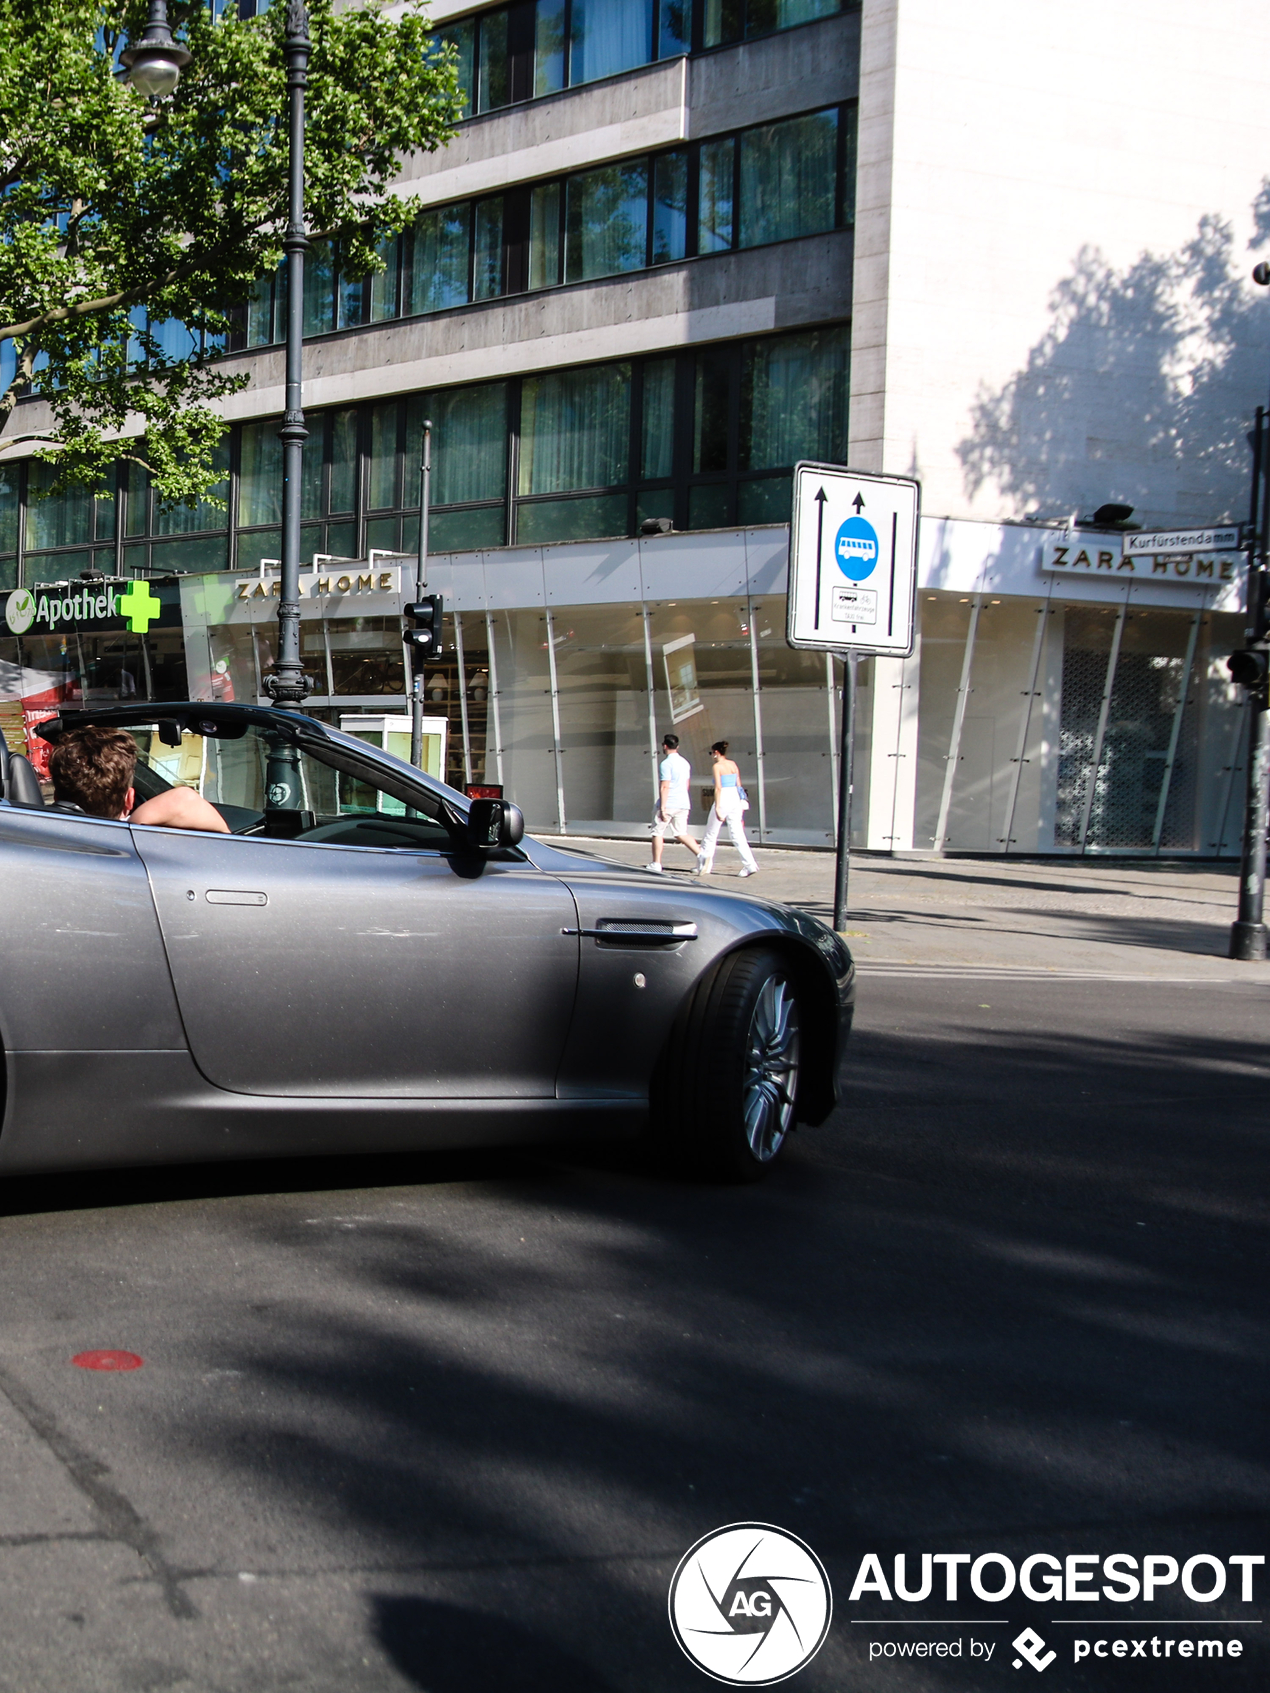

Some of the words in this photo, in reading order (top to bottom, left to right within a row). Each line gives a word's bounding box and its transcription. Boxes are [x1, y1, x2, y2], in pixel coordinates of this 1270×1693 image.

[1129, 532, 1235, 549] Kurfürstendamm
[1052, 547, 1134, 571] ZARA
[1152, 555, 1234, 580] HOME
[318, 572, 394, 593] HOME
